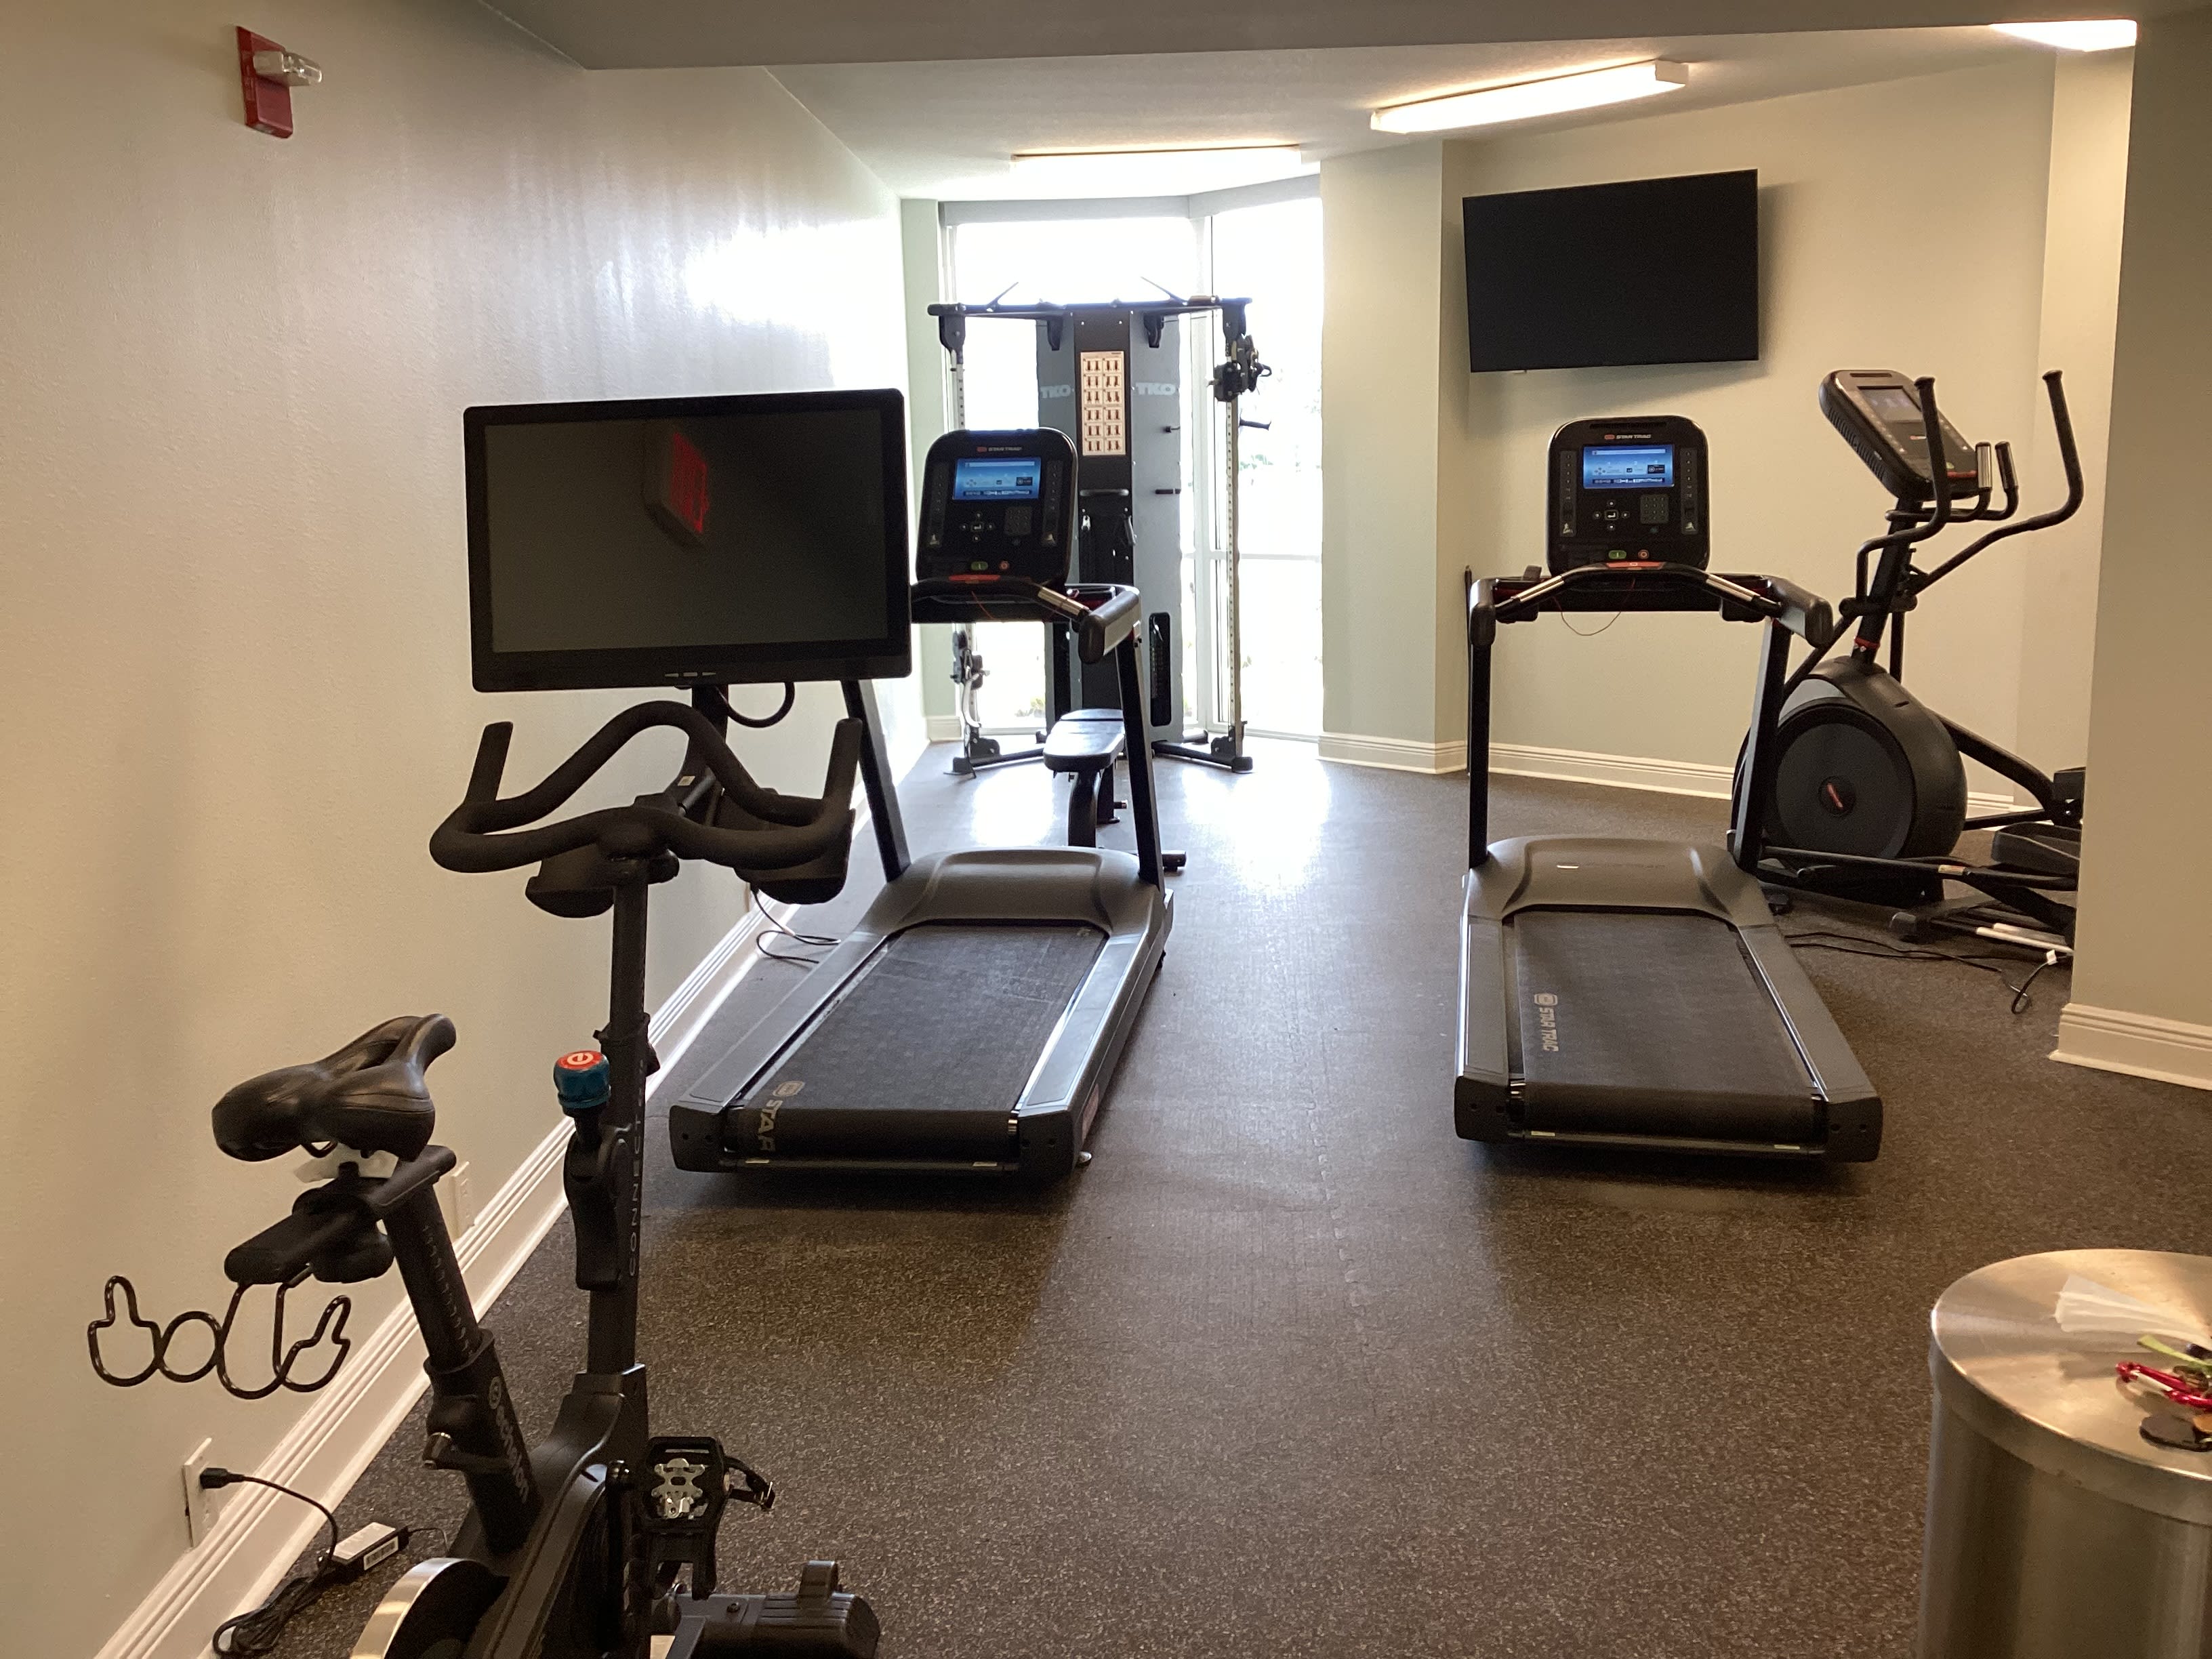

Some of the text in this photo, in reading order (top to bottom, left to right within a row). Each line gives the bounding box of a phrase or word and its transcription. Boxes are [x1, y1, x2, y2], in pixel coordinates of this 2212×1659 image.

[1040, 384, 1071, 398] TKO
[1136, 382, 1176, 396] TKO
[1539, 1007, 1559, 1052] STAR TRAC
